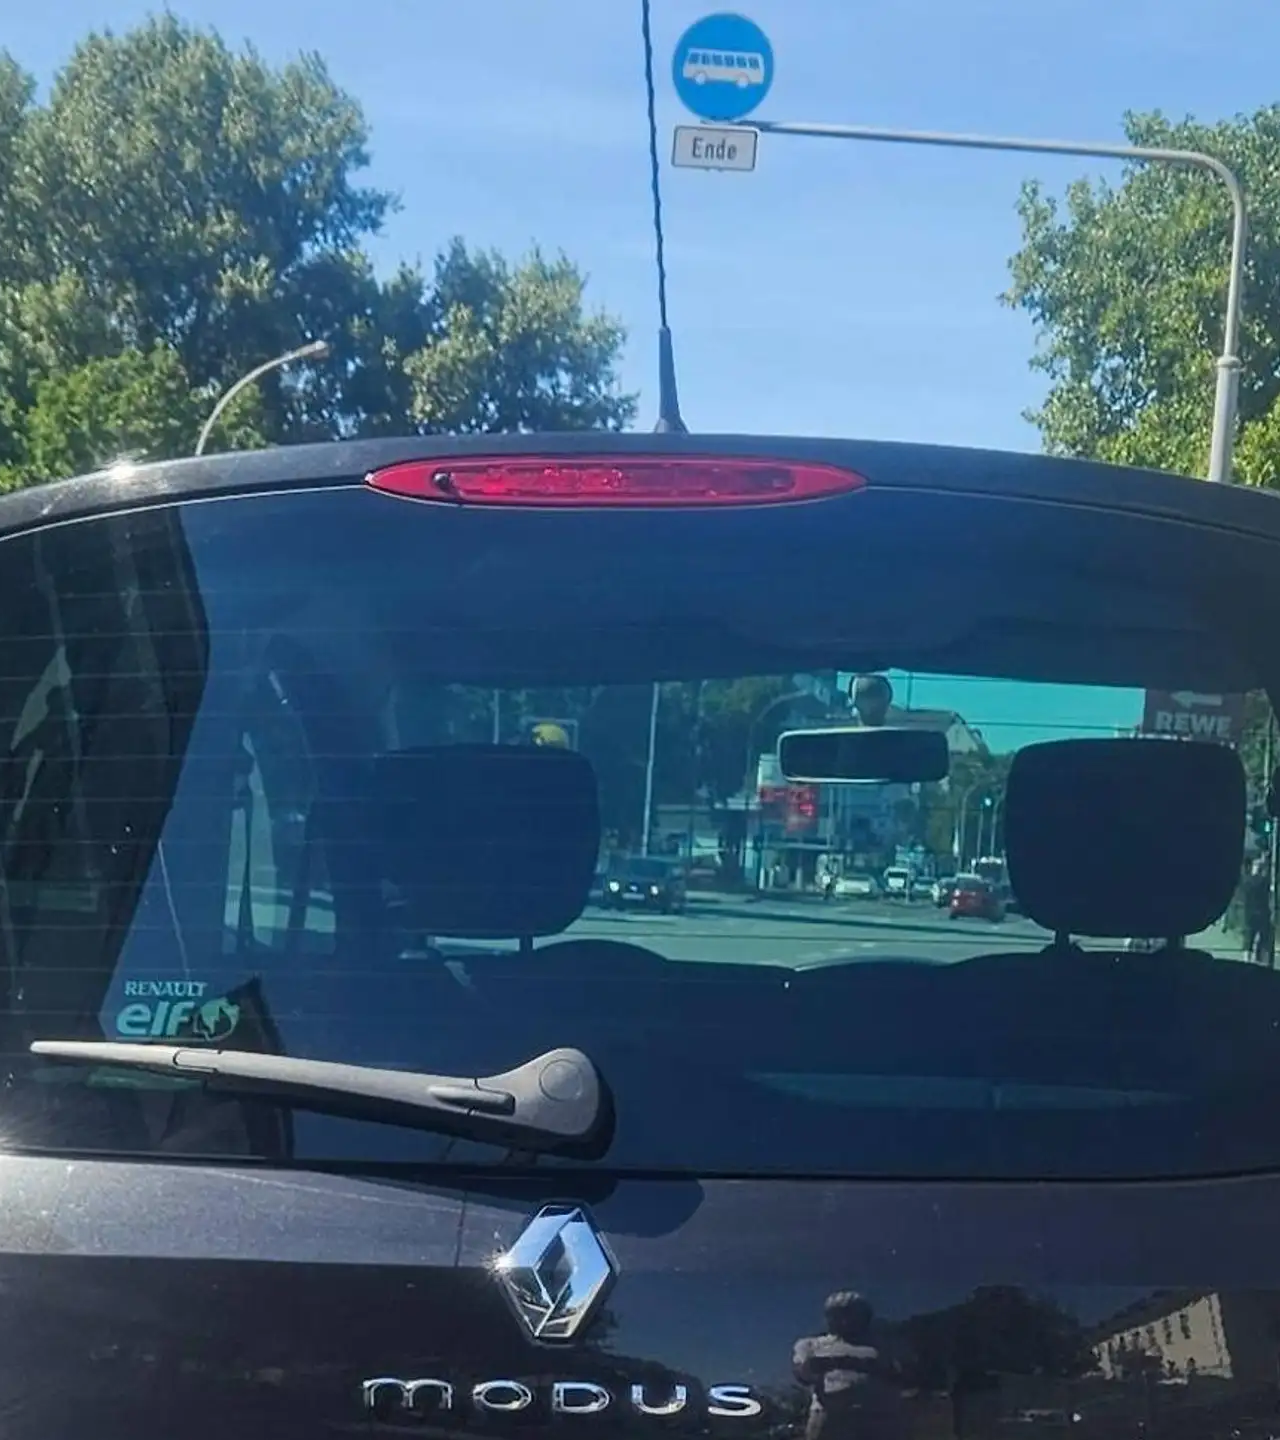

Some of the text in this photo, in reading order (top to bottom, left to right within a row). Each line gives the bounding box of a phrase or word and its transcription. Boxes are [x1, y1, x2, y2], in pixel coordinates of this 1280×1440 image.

[692, 136, 738, 160] Ende
[1155, 711, 1232, 739] REWE
[124, 980, 208, 997] RENAULT
[116, 1000, 196, 1037] elf
[362, 1376, 764, 1418] MODUS
